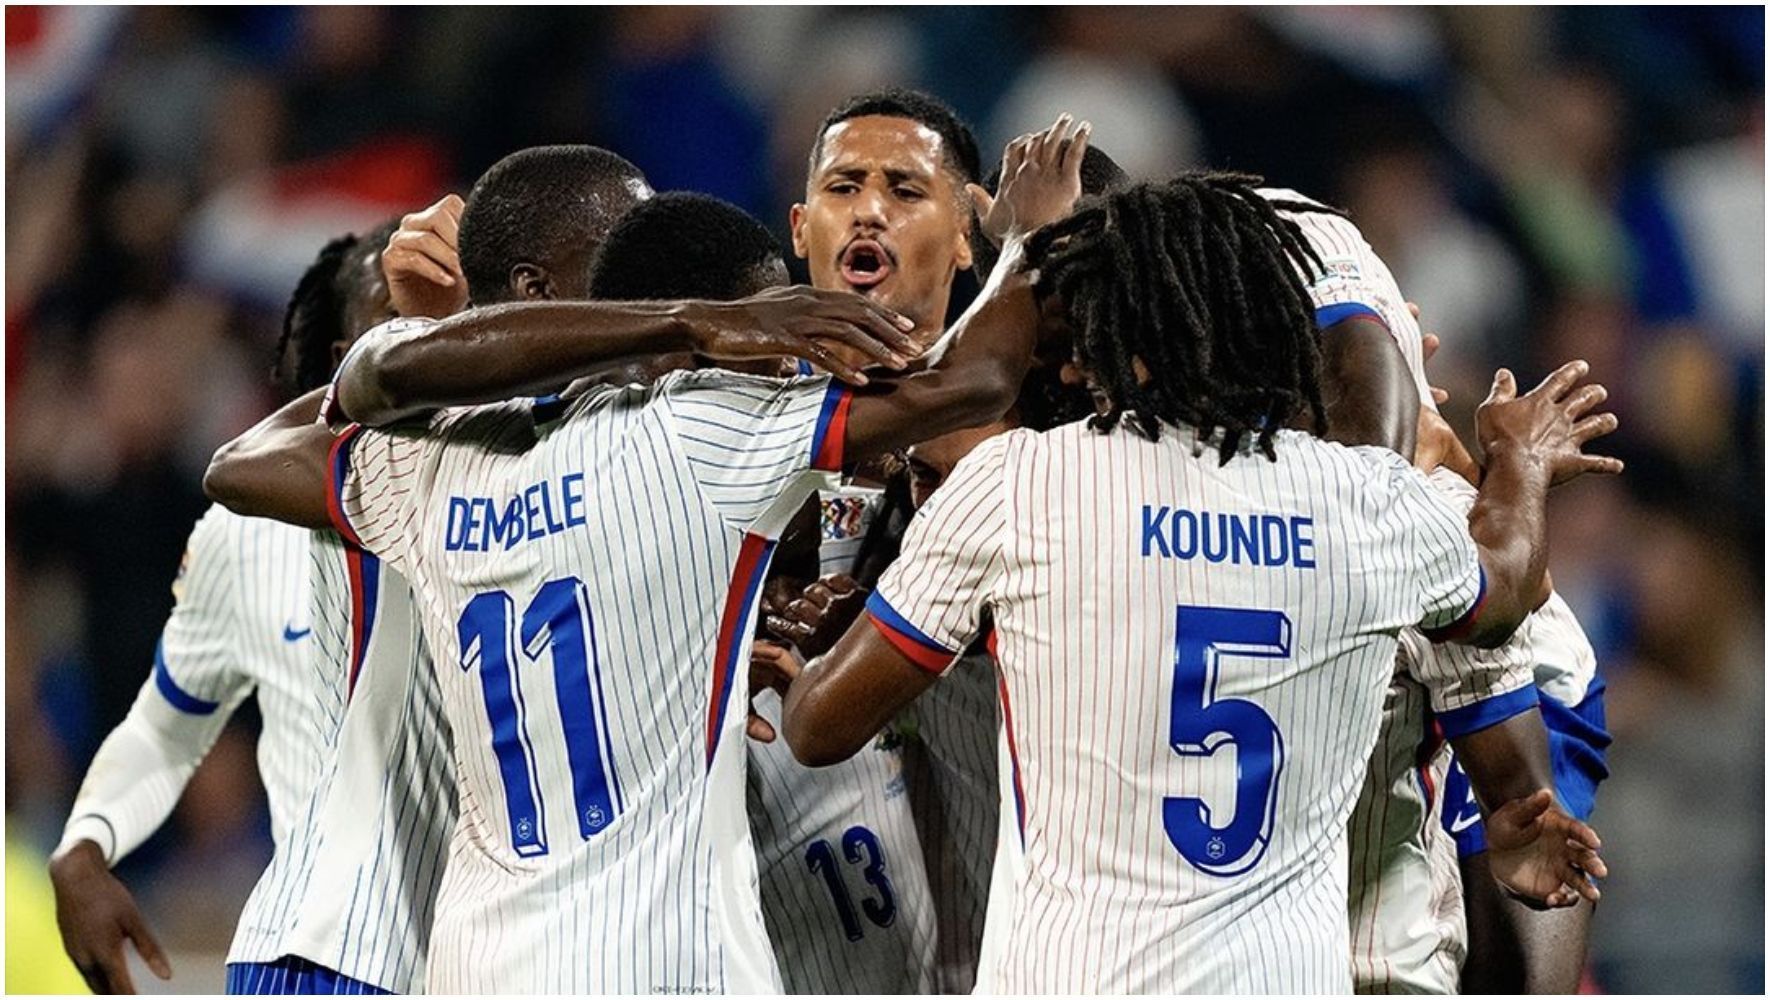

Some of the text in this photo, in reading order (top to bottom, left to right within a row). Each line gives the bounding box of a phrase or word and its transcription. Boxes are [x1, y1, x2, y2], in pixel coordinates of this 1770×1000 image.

[446, 473, 586, 552] DEMBELE
[1141, 505, 1316, 569] KOUNDE
[457, 575, 624, 858] 11
[1162, 604, 1292, 878] 5
[805, 826, 897, 943] 13
